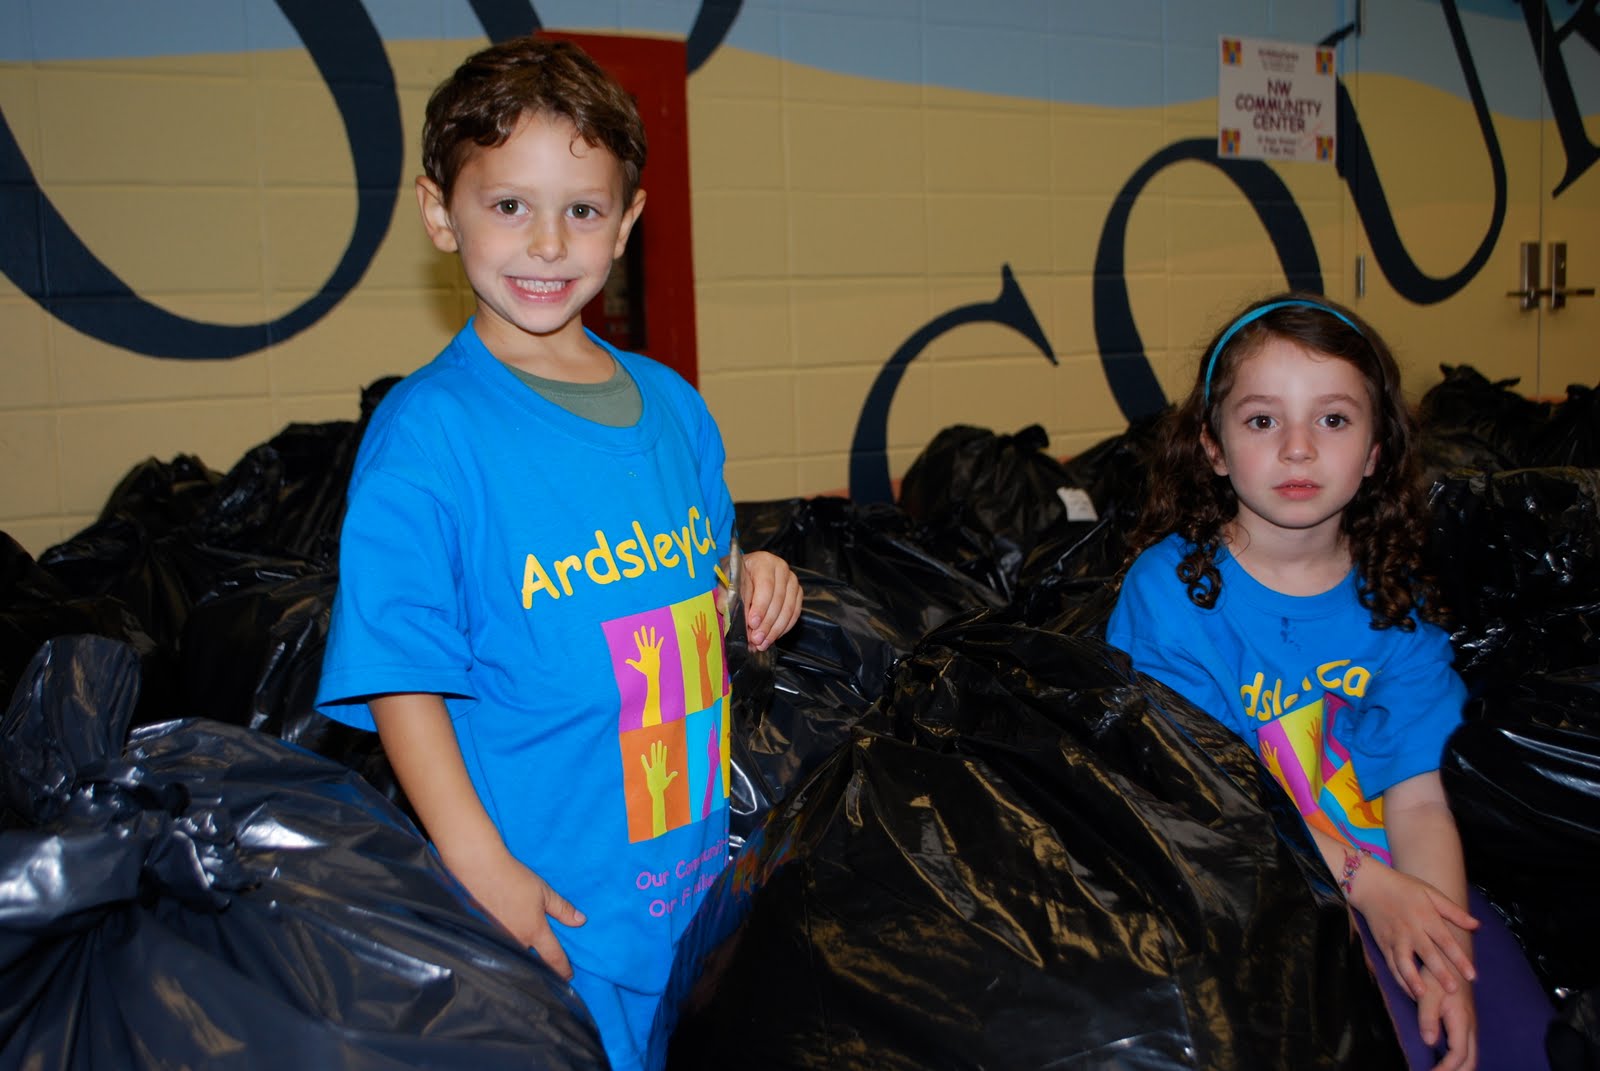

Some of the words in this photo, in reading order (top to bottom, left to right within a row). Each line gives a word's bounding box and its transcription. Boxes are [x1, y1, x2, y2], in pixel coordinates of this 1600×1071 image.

[1267, 79, 1293, 97] NW
[1235, 94, 1322, 117] COMMUNITY
[1252, 113, 1305, 133] CENTER
[635, 871, 670, 890] Our
